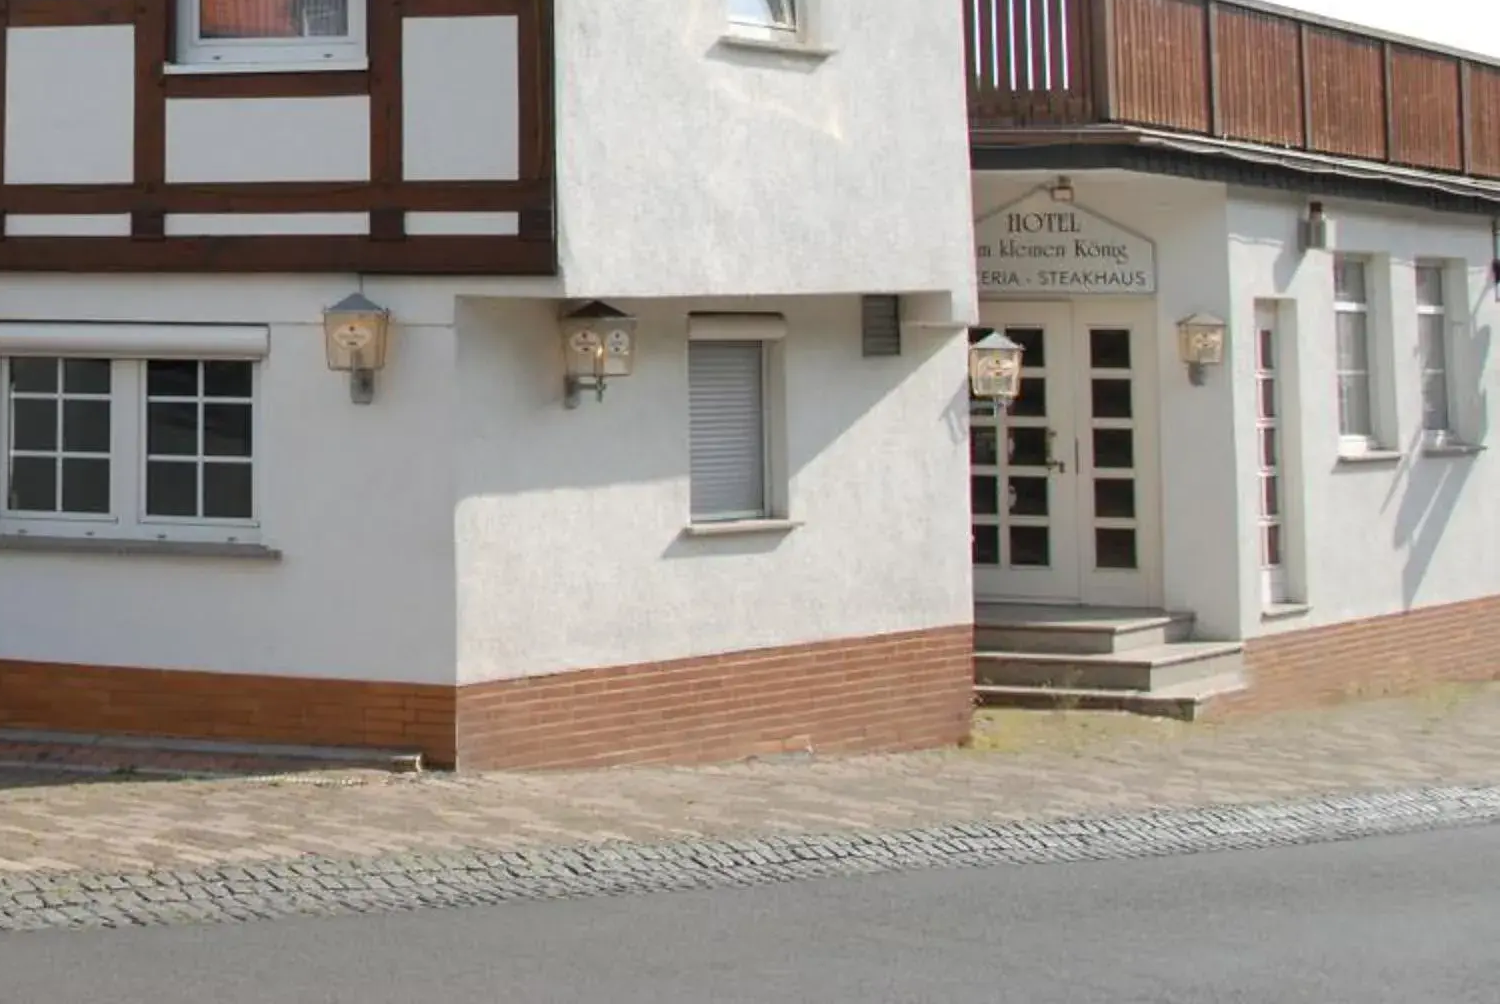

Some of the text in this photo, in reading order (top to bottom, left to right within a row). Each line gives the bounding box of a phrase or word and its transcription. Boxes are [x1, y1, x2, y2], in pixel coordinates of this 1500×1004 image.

[1006, 212, 1081, 233] HOTEL
[999, 238, 1066, 258] kleinen
[1074, 238, 1129, 264] König
[981, 270, 1020, 285] ERIA
[1037, 269, 1147, 286] STEAKHAUS
